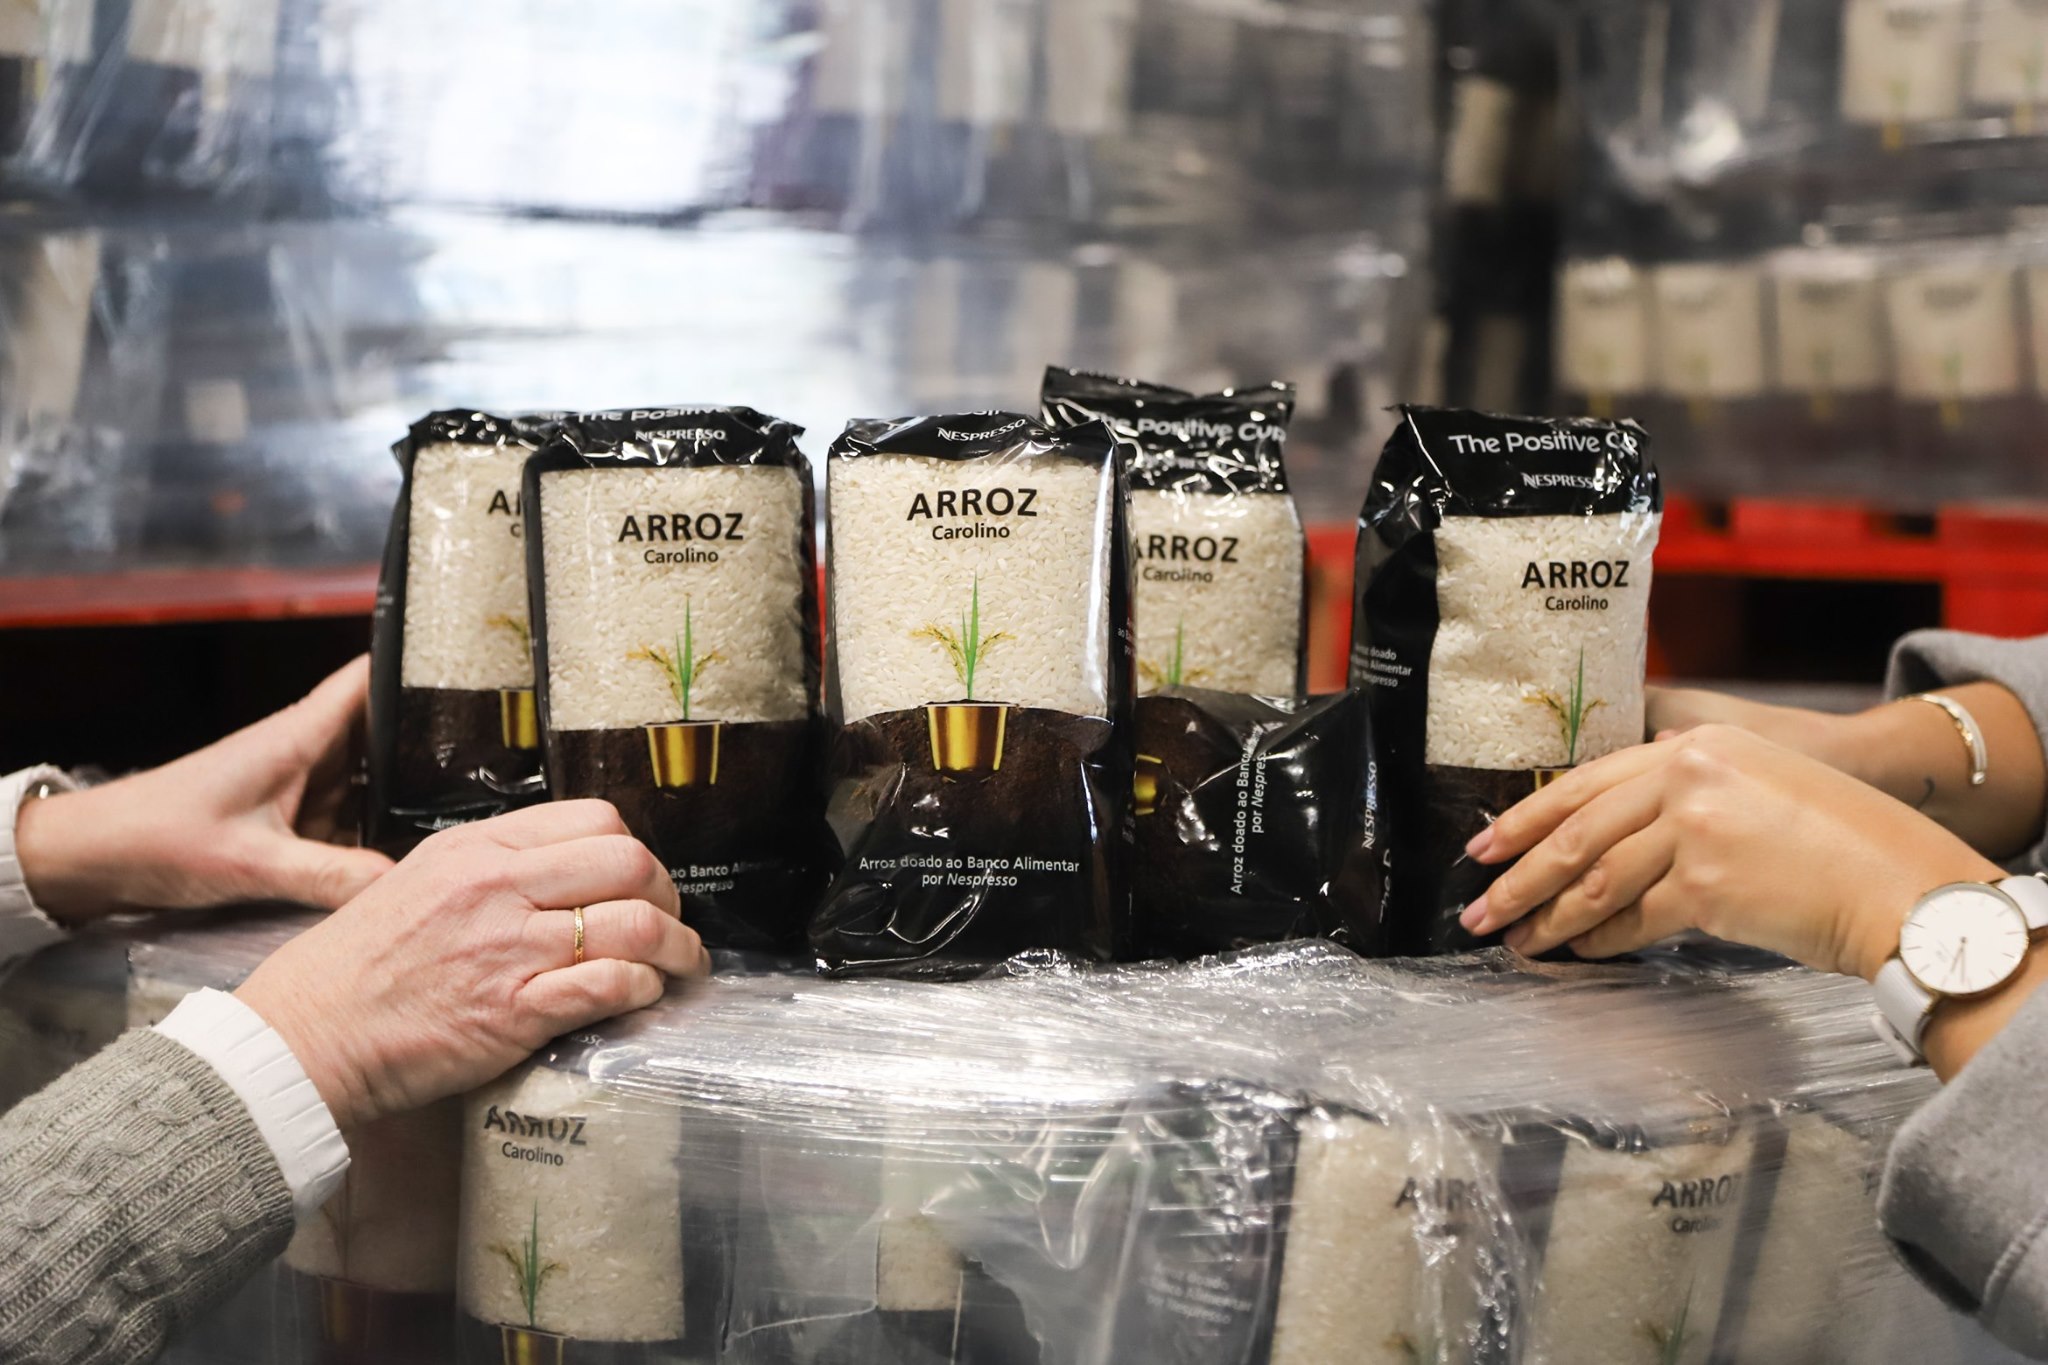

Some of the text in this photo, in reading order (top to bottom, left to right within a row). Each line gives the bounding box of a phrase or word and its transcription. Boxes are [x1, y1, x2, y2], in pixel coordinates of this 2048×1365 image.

[937, 418, 1026, 442] NESPRESSO
[1447, 433, 1501, 454] The
[1504, 430, 1601, 453] Positive
[906, 488, 1038, 521] ARROZ
[617, 512, 744, 543] ARROZ
[932, 522, 1011, 541] Carolino
[643, 548, 720, 565] Carolino
[1142, 566, 1214, 583] Carolino
[1521, 560, 1630, 589] ARROZ
[1545, 595, 1609, 611] Carolino
[1237, 790, 1248, 808] ao
[1361, 761, 1378, 850] NESPRESSO
[1231, 810, 1247, 854] doado
[1251, 810, 1265, 834] por
[670, 868, 686, 879] ao
[689, 865, 729, 878] Banco
[859, 855, 1080, 873] Arroz doado ao Banco Alimentar
[1230, 856, 1244, 895] Arroz
[921, 872, 1018, 889] por Nespresso
[501, 1141, 564, 1167] Carolino
